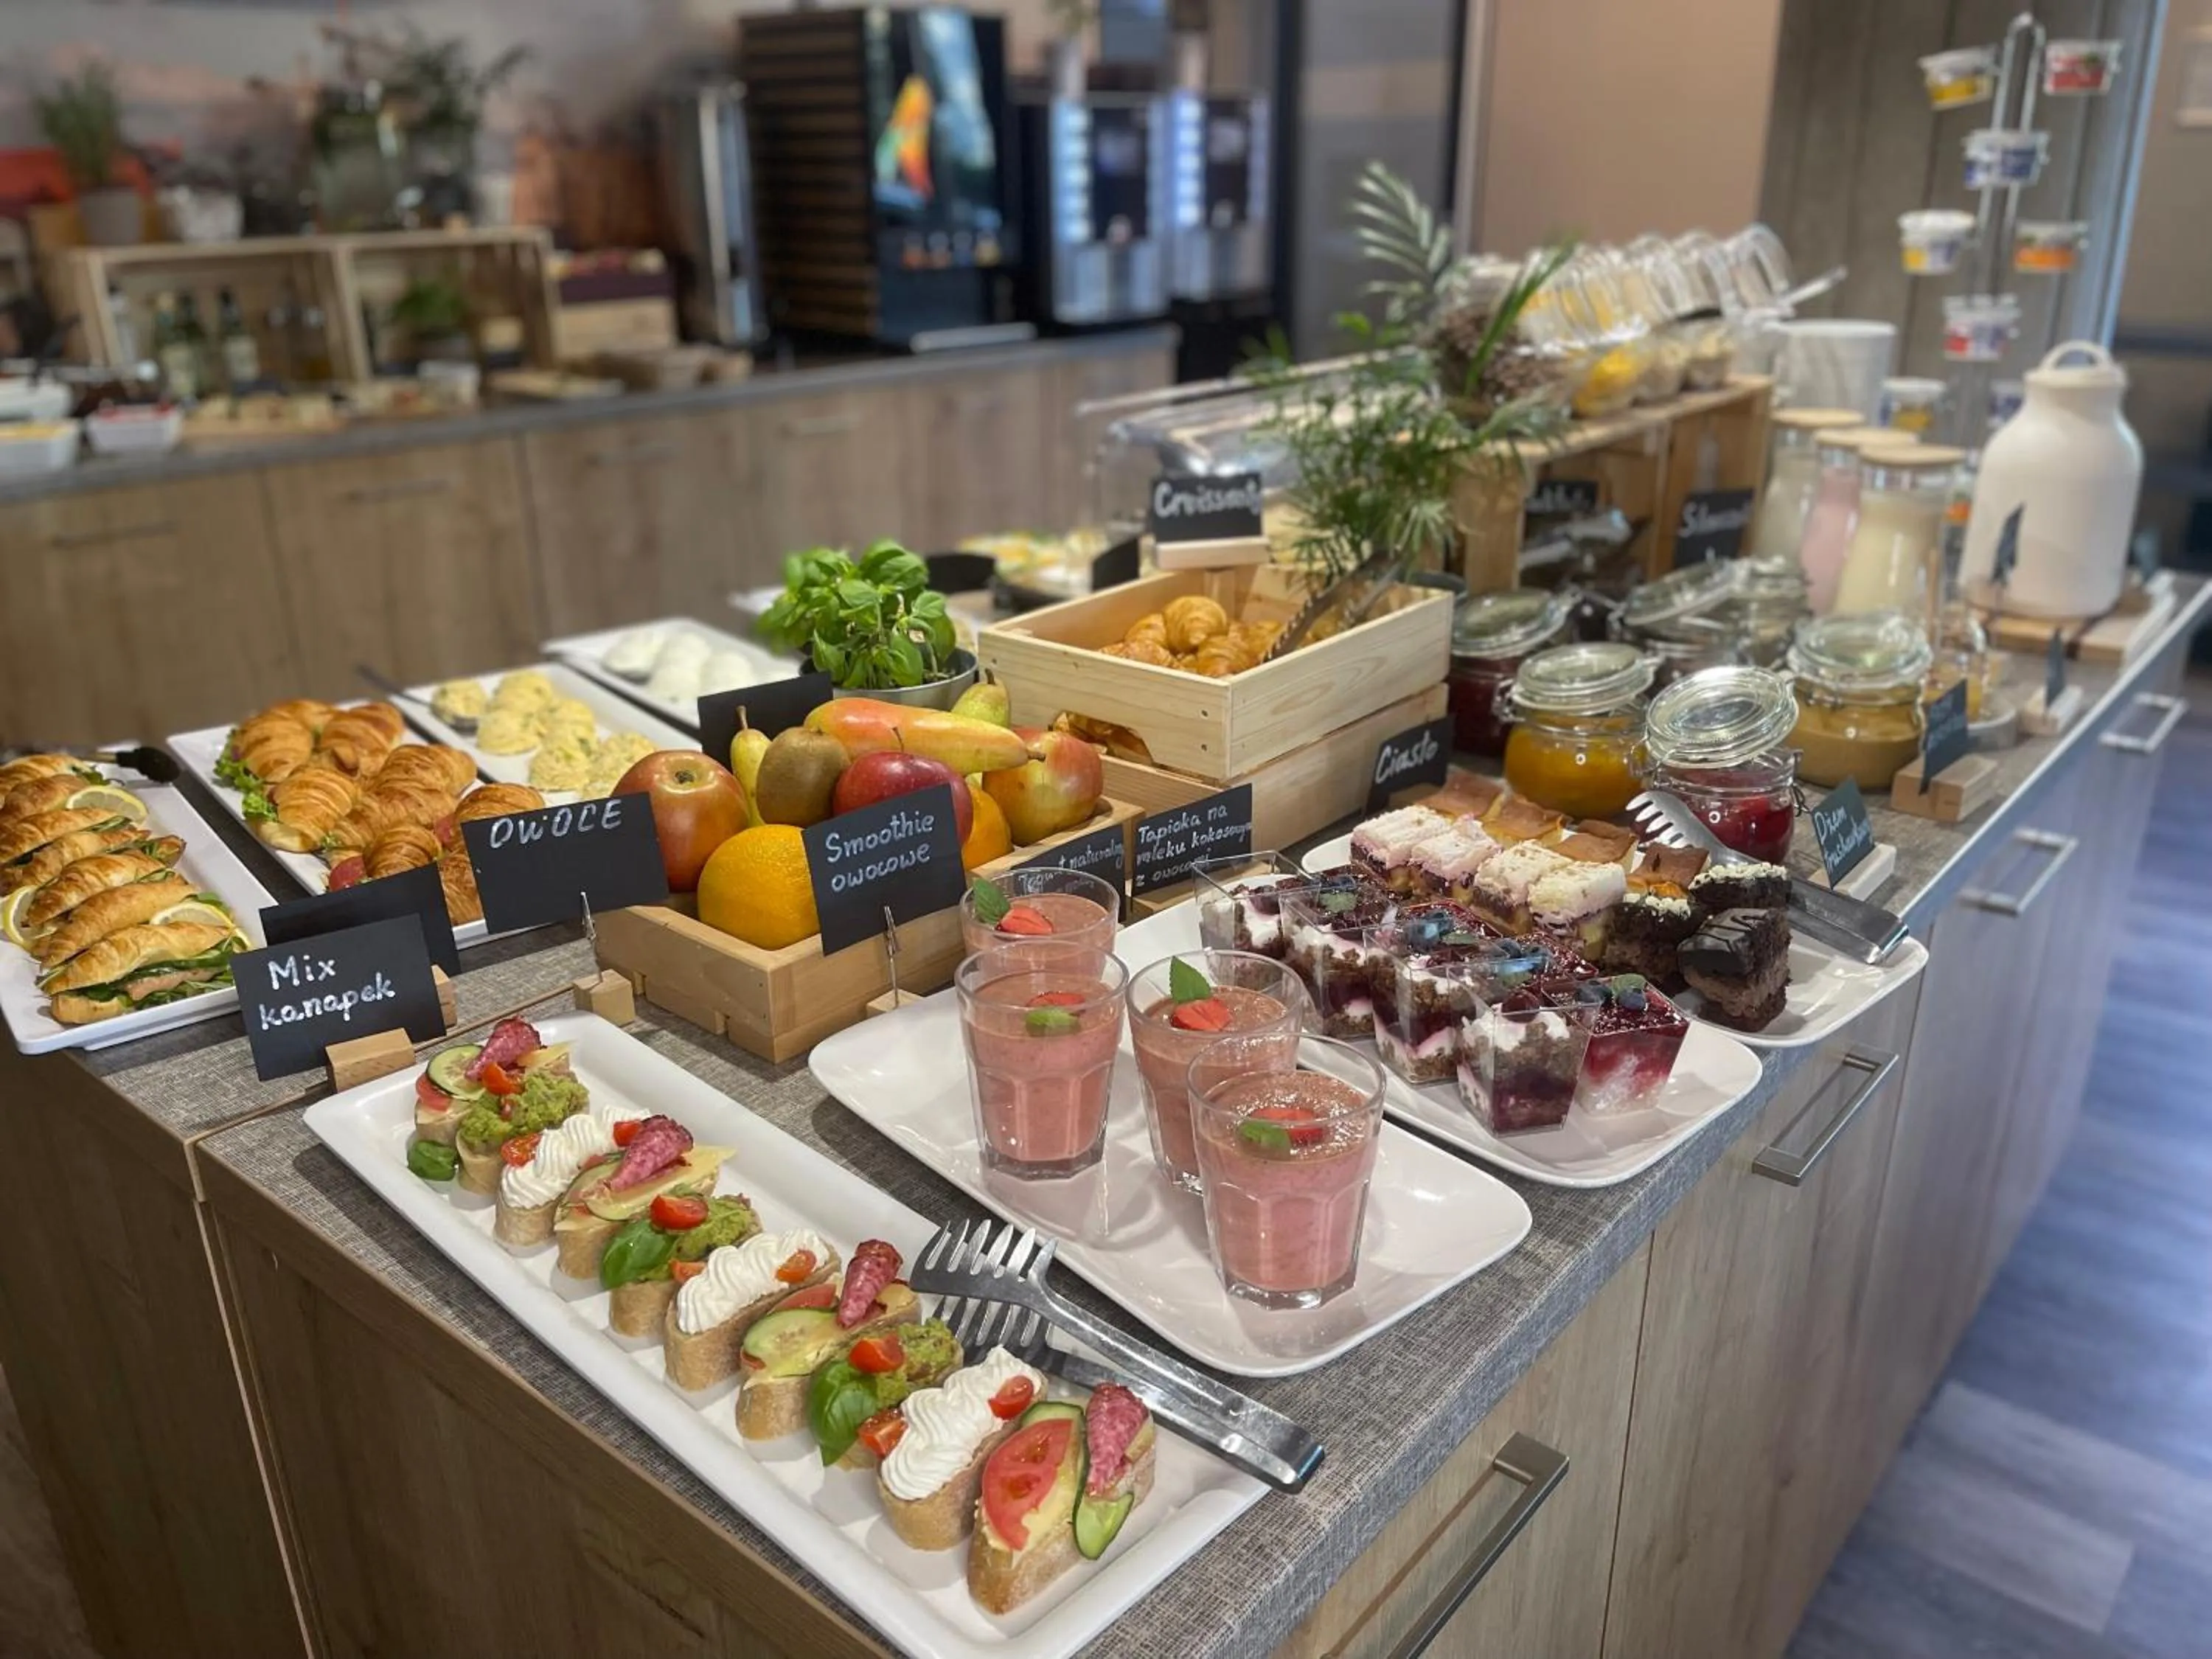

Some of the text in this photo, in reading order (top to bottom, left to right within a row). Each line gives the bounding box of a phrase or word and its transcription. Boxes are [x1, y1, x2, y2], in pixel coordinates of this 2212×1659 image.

[1375, 730, 1438, 785] Ciasto
[825, 810, 935, 863] Smoothie
[1138, 804, 1228, 846] Tapioka na
[831, 844, 931, 891] owocowe
[1135, 840, 1186, 866] mleku
[1135, 873, 1146, 888] z
[267, 954, 337, 990] Mix
[258, 971, 396, 1032] kanapek
